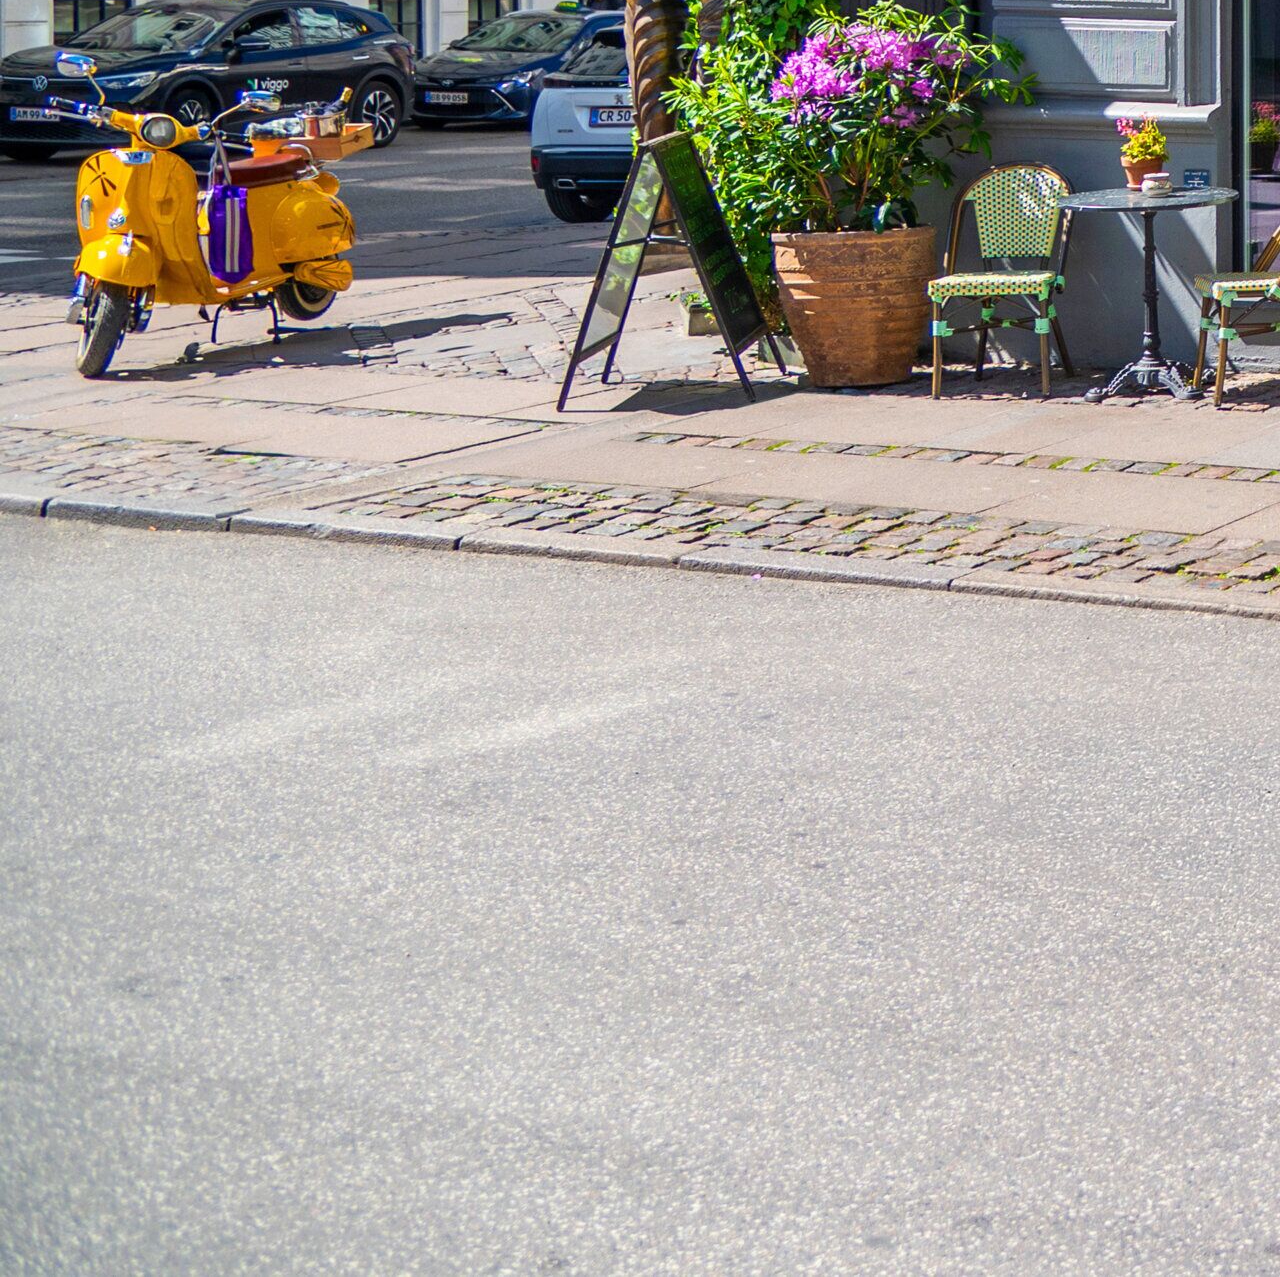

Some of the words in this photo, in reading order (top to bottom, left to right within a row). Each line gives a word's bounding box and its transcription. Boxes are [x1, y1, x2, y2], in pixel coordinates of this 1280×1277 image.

[260, 77, 289, 92] viggo
[599, 110, 614, 122] CR
[617, 110, 632, 122] 50
